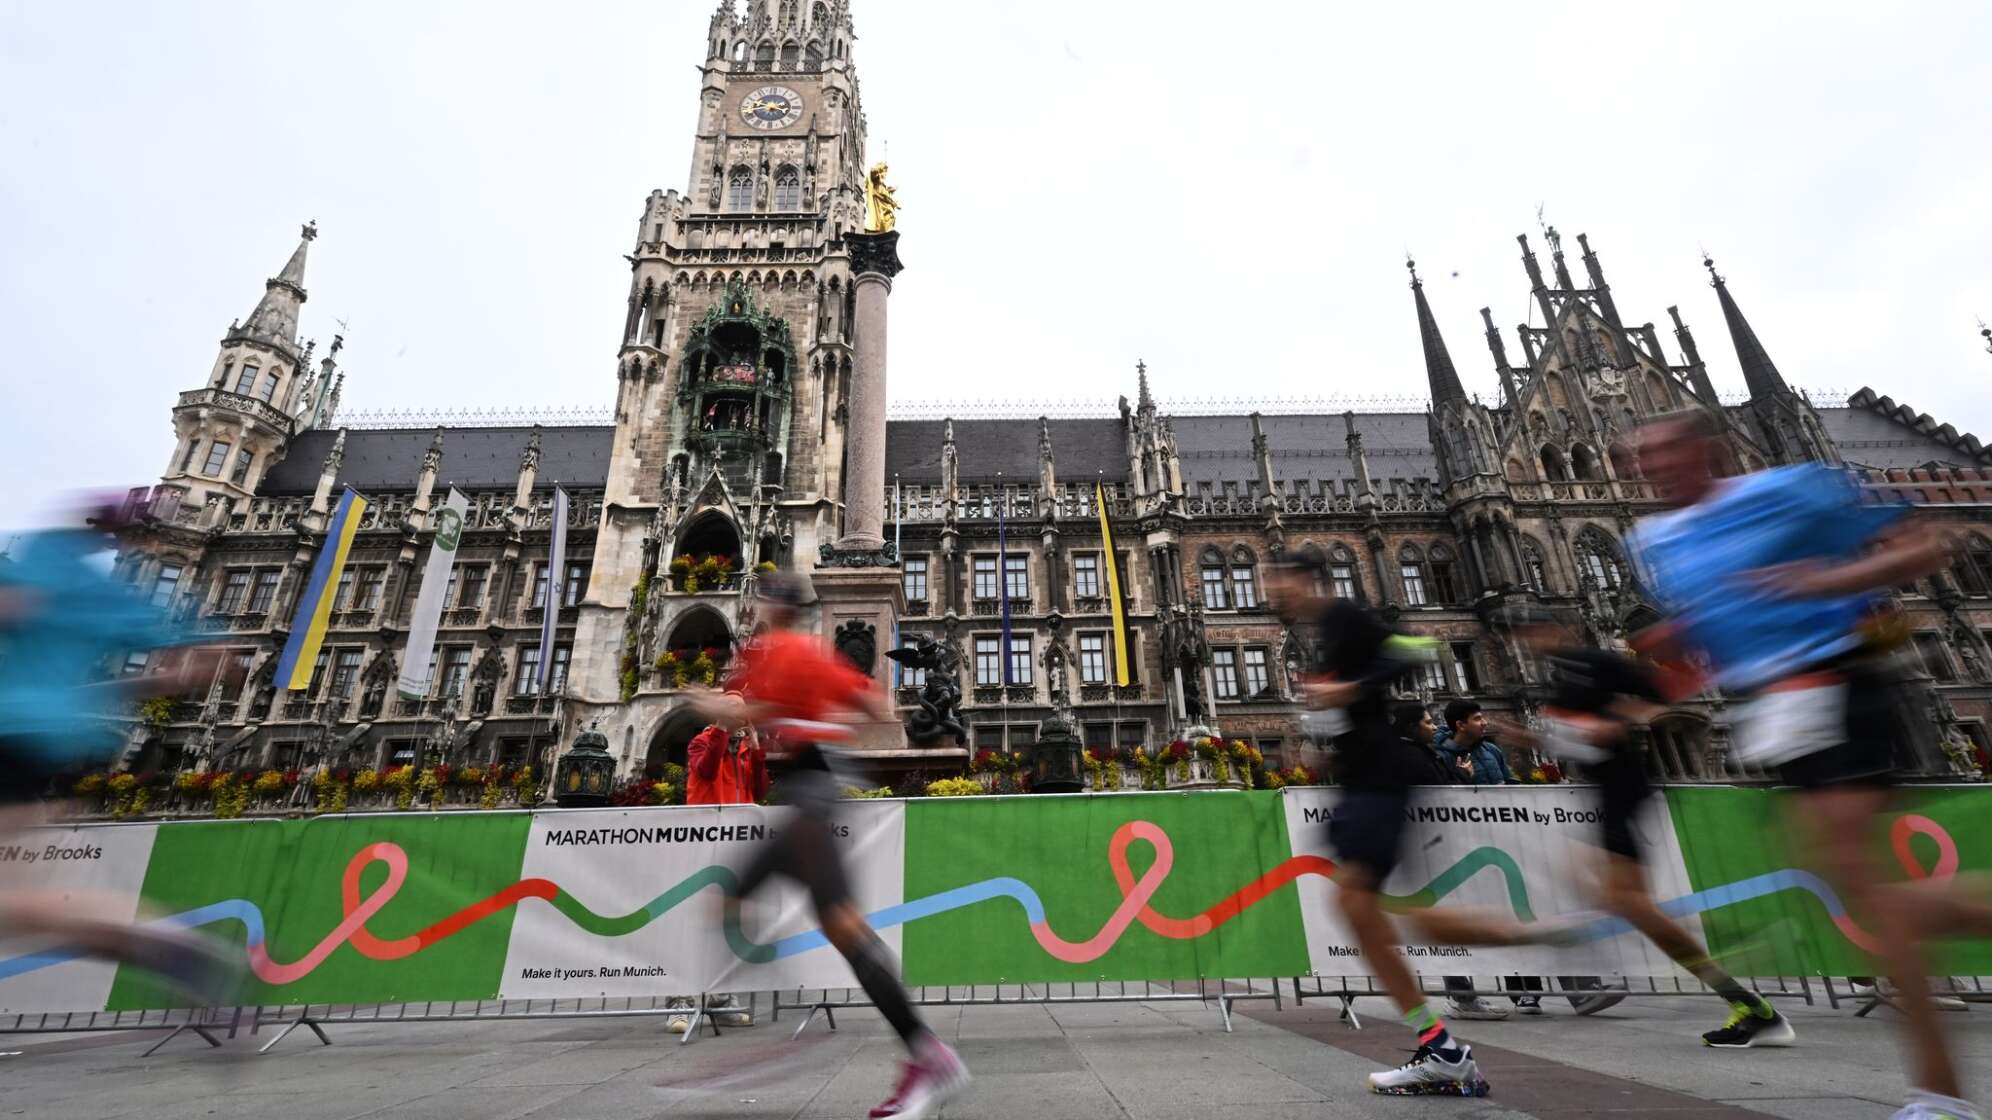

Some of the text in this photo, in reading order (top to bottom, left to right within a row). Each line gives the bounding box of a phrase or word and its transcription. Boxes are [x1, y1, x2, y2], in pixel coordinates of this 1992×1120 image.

[1533, 810, 1550, 826] by
[1553, 807, 1608, 823] Brook
[22, 848, 40, 863] by
[43, 844, 102, 861] Brooks
[1328, 946, 1360, 957] Make
[1407, 945, 1427, 957] Run
[1429, 946, 1472, 957] Munich.
[521, 965, 668, 981] Make it yours. Run Munich.
